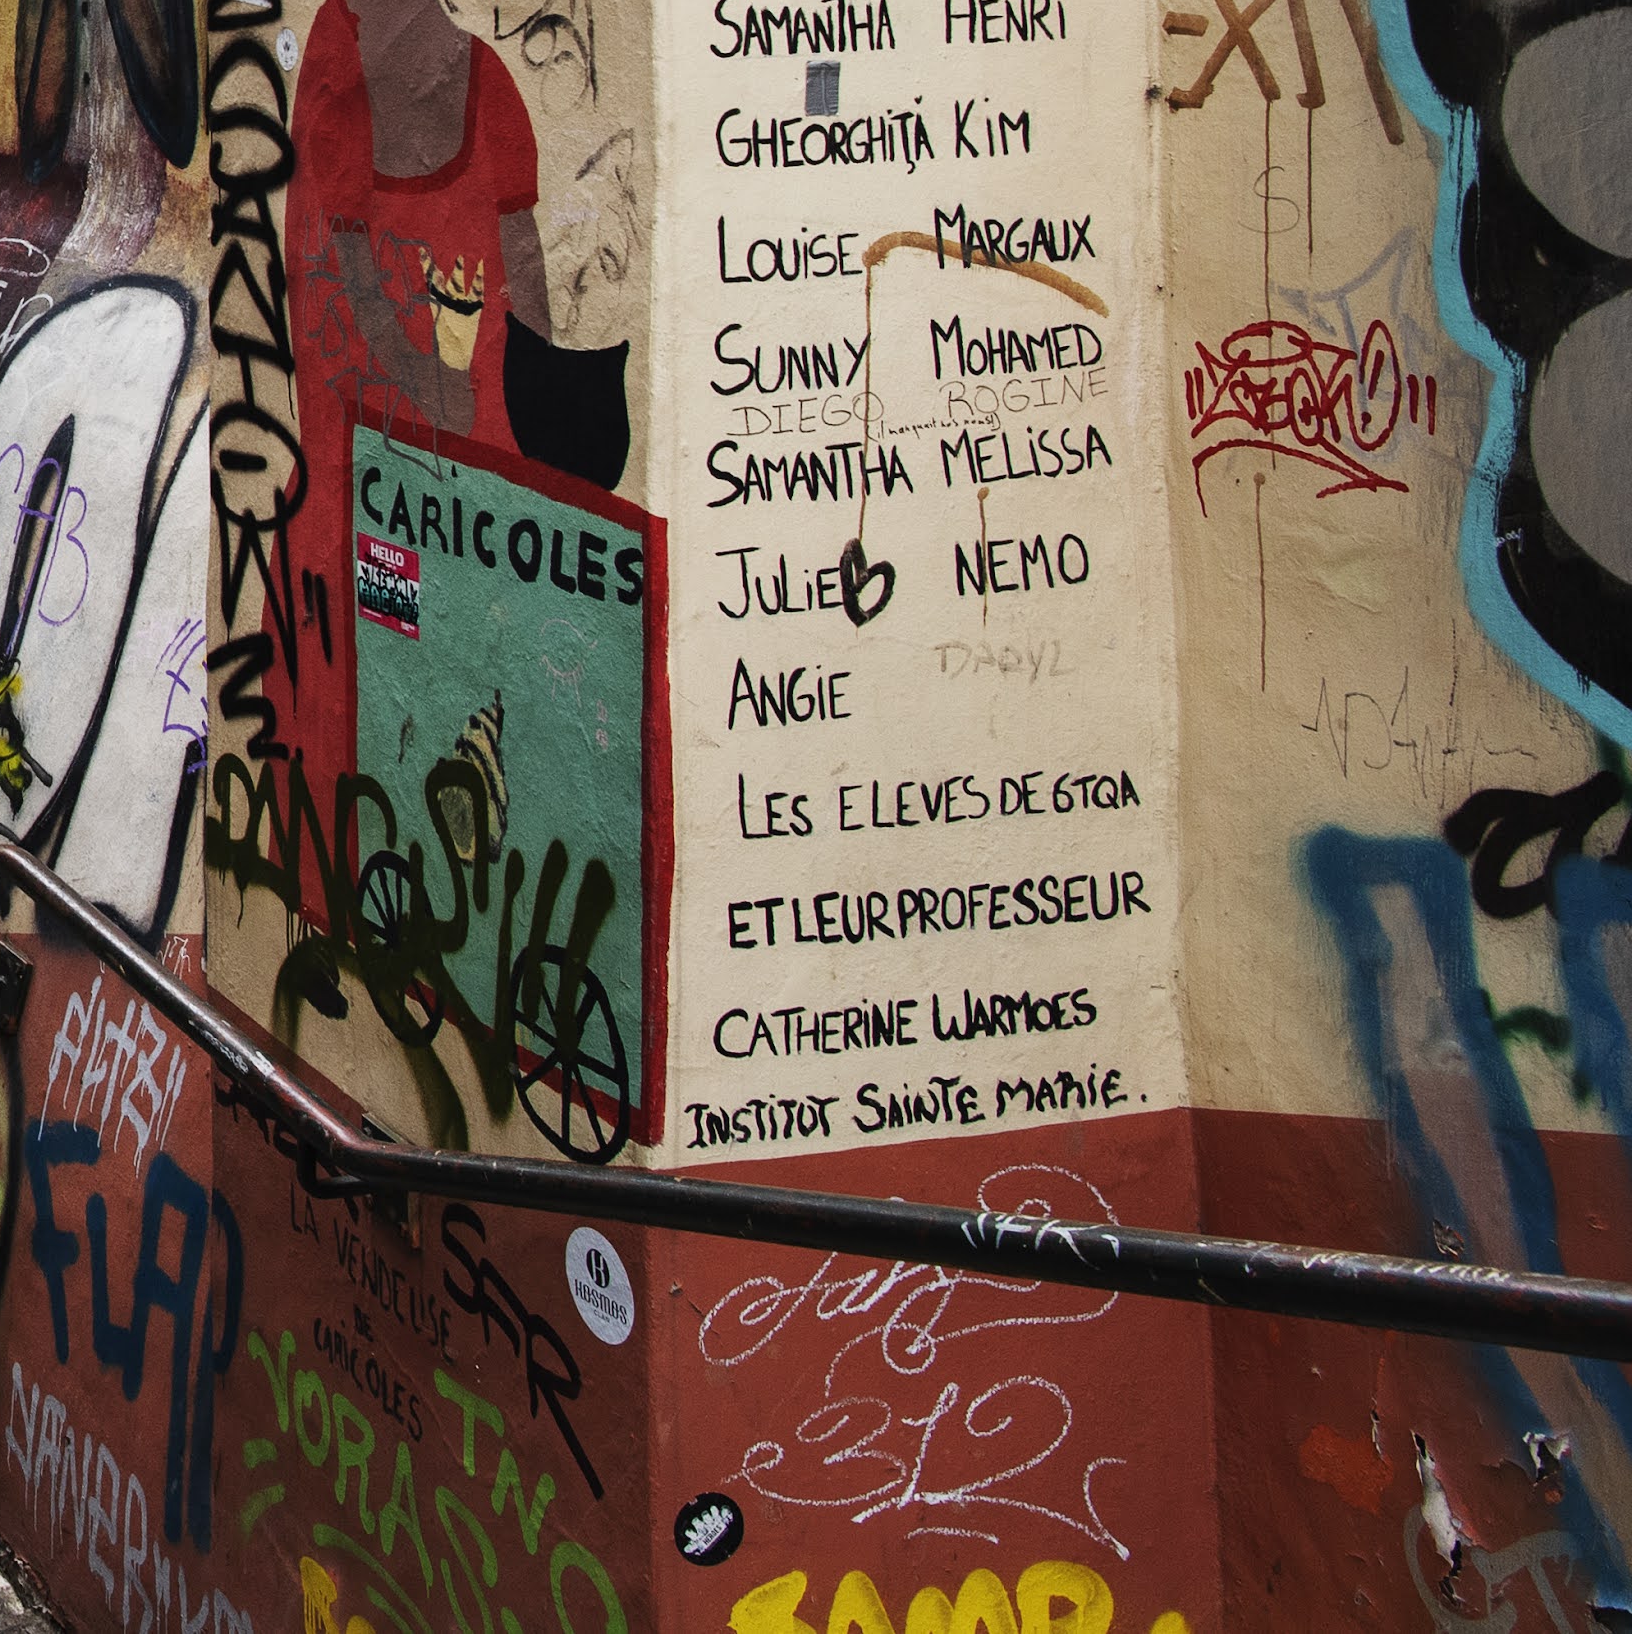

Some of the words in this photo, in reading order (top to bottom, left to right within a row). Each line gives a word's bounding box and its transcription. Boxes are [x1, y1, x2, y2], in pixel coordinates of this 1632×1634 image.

[718, 214, 863, 283] LOUISE
[933, 204, 1095, 270] MARGAUX
[710, 323, 872, 397] SUNNY
[930, 315, 1103, 381] MOHAMED
[726, 391, 885, 437] DIEGO
[706, 439, 914, 508] SAMANTHA
[370, 542, 405, 568] HELLO
[955, 534, 1090, 597] NEMO
[727, 657, 853, 730] ANGIE
[737, 772, 813, 839] LES
[839, 775, 990, 831] ELEVES
[1000, 774, 1047, 817] DE
[728, 897, 785, 949] ET
[793, 890, 897, 945] LEUR
[897, 870, 1152, 939] PROFESSEUR
[931, 987, 1097, 1042] WARMOES
[290, 1180, 320, 1244] LA
